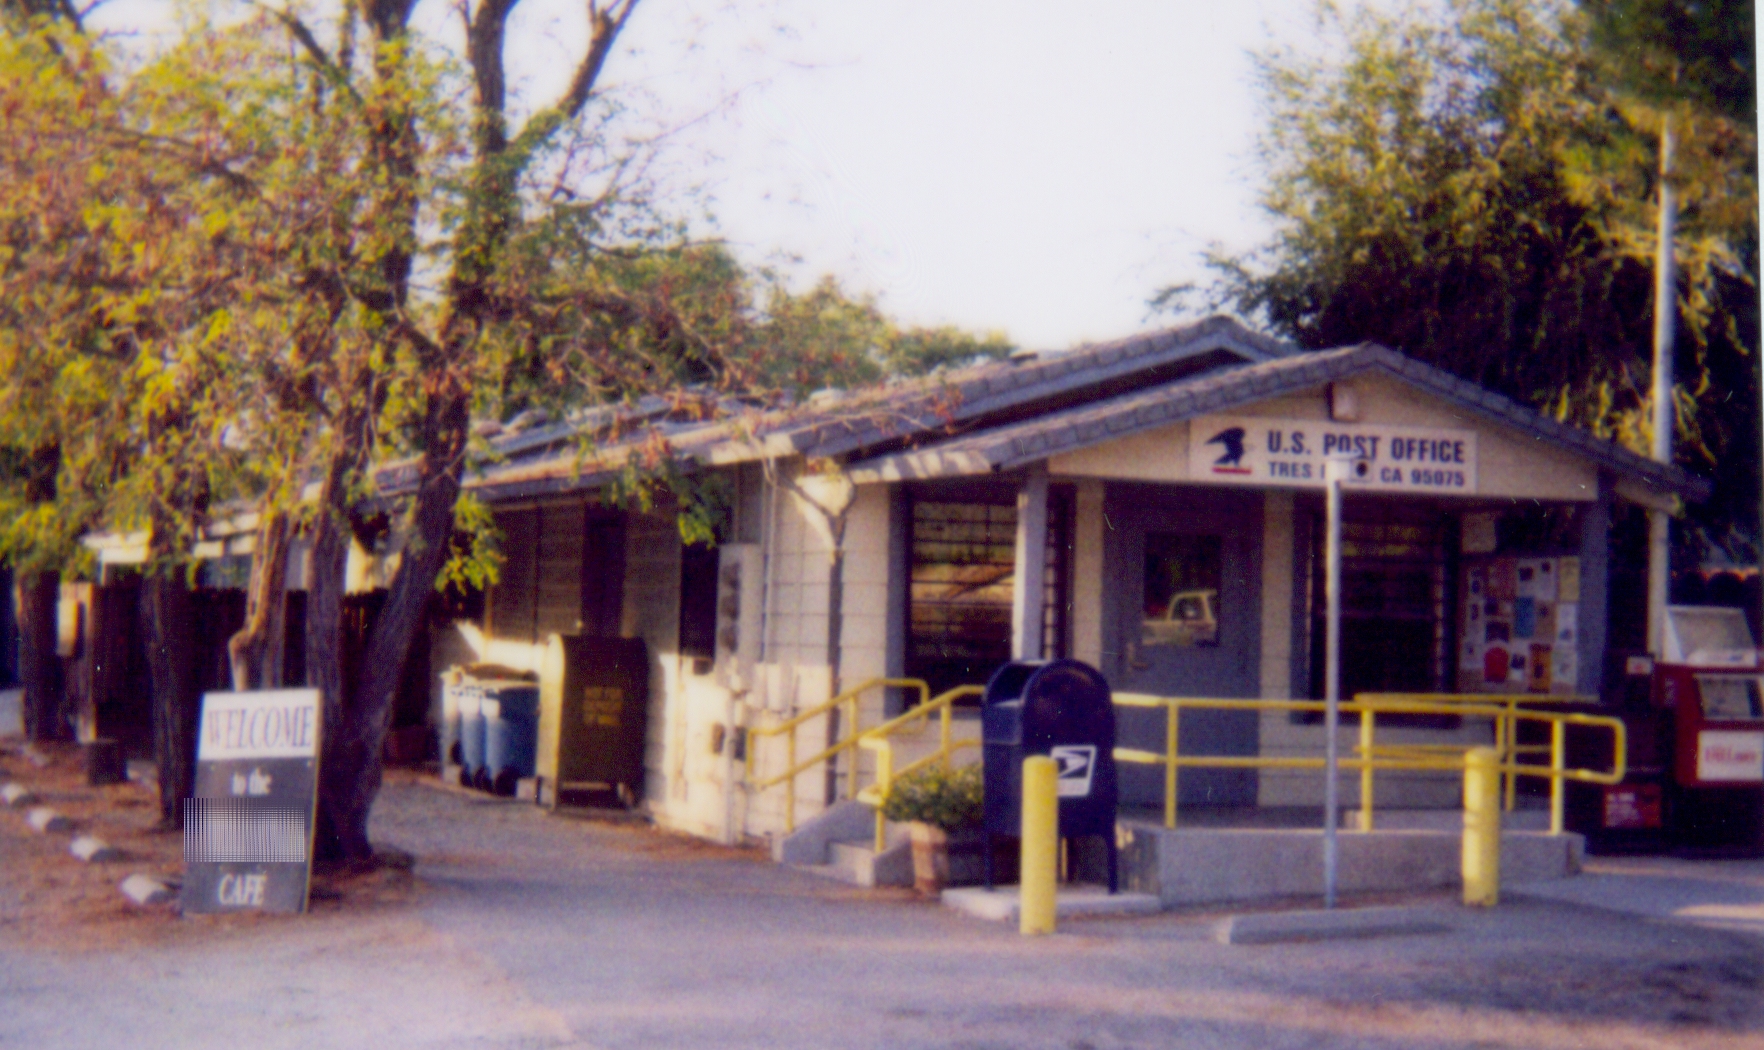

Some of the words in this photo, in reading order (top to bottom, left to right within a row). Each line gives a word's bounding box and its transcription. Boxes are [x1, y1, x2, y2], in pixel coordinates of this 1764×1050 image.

[1267, 430, 1311, 455] U.S.
[1323, 433, 1381, 461] POST
[1391, 437, 1464, 464] OFFICE
[1269, 461, 1311, 478] TRES
[1381, 467, 1402, 483] CA
[1411, 469, 1464, 487] 95075
[207, 706, 314, 750] WELCOME
[249, 767, 271, 794] the
